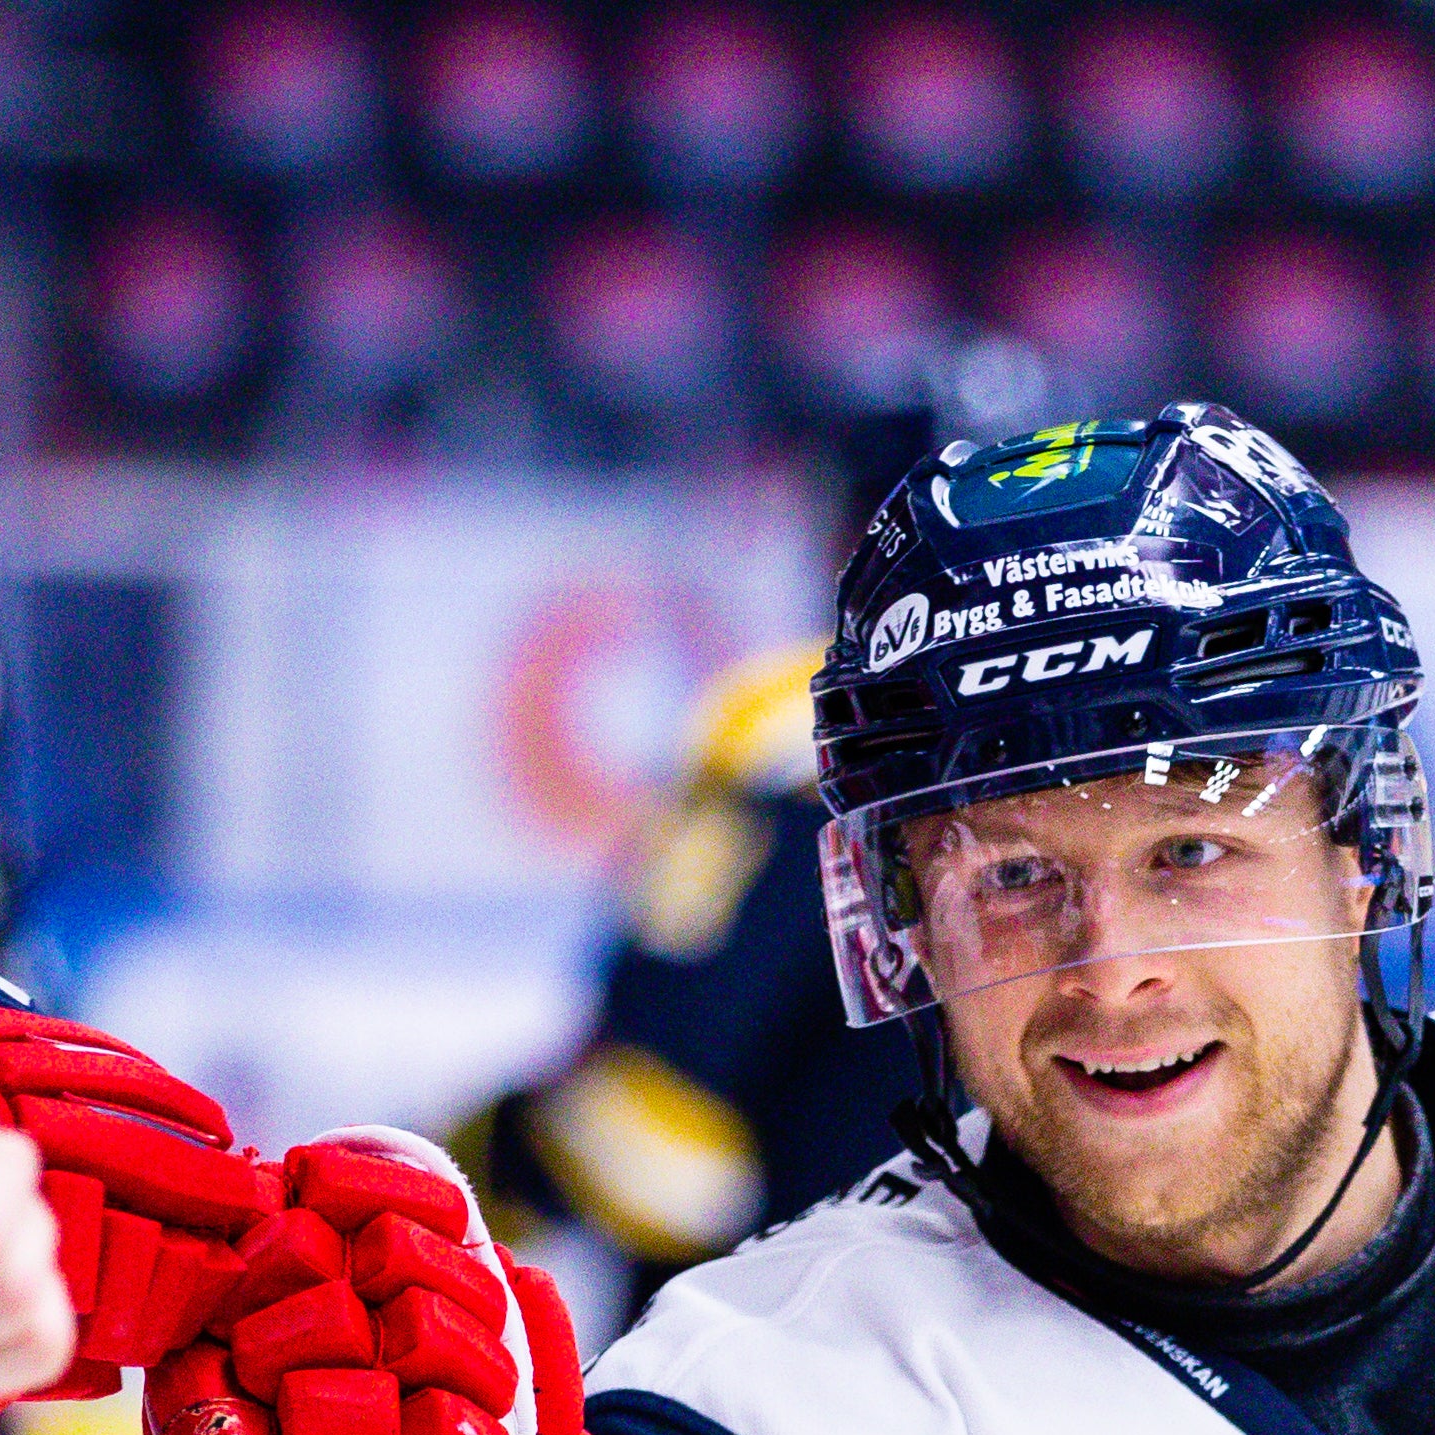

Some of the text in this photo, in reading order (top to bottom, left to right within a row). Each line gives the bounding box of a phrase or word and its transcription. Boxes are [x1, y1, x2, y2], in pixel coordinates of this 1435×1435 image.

[983, 541, 1140, 588] Västerviks
[933, 603, 1005, 640] Bygg
[1012, 589, 1036, 619] &
[956, 629, 1156, 697] CCM
